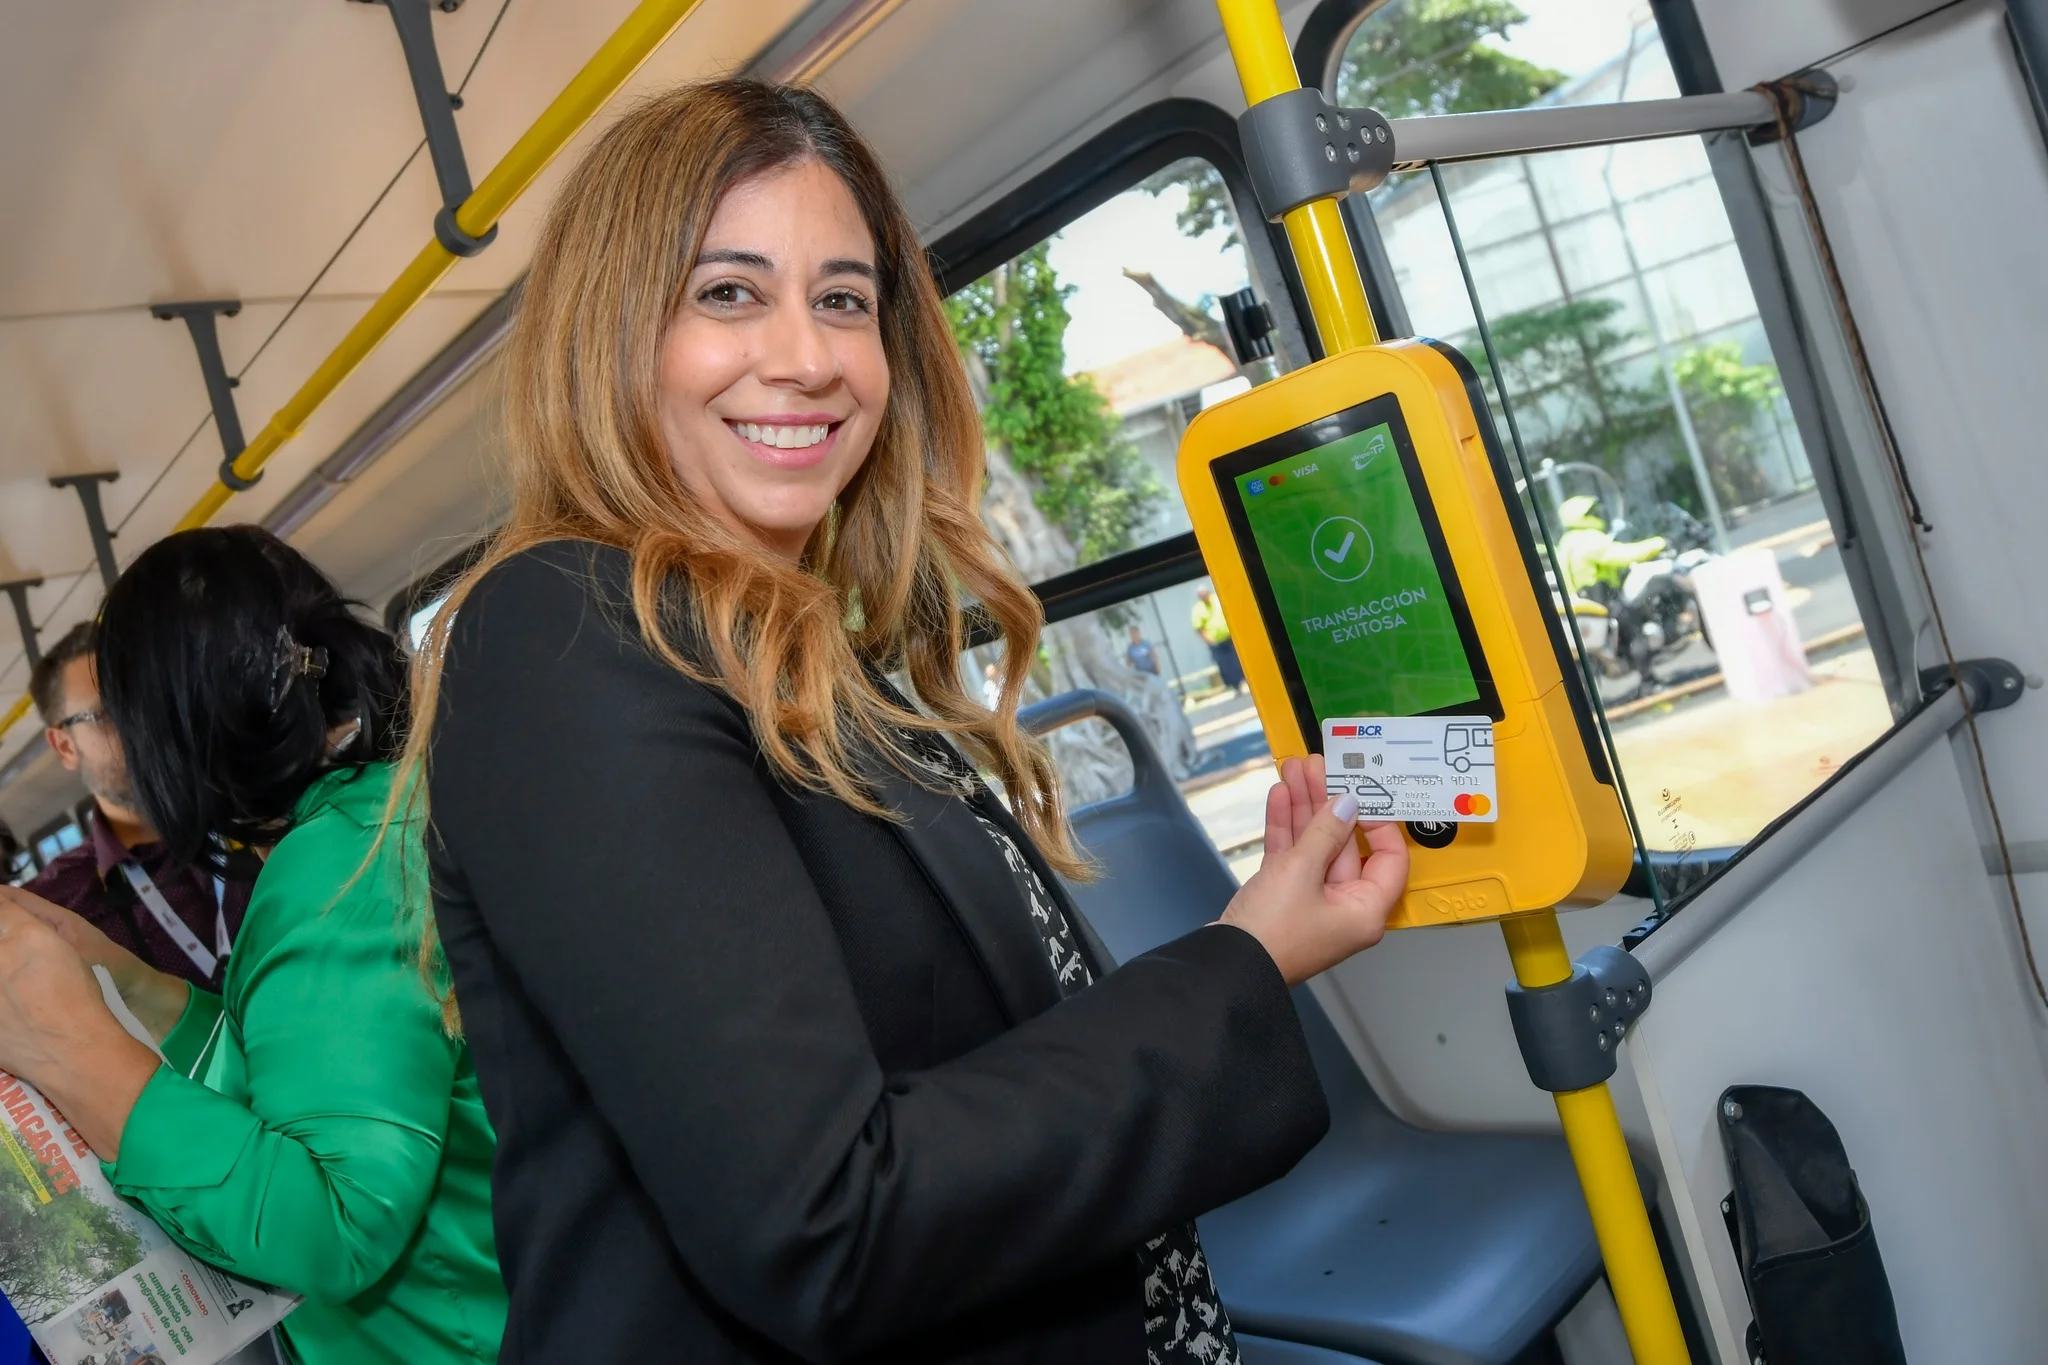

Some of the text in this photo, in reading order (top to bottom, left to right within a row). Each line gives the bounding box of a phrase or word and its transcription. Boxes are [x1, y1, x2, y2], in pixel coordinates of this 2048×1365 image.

[1292, 463, 1319, 478] VISA
[1301, 587, 1427, 633] TRANSACCIÓN
[1332, 613, 1407, 643] EXITOSA
[1357, 725, 1382, 736] BCR
[1380, 775, 1407, 785] 1802
[0, 1068, 81, 1195] ANACASTE
[148, 1271, 194, 1343] cumpliendo con
[170, 1283, 192, 1317] Vienen
[182, 1273, 209, 1316] CORONADO
[132, 1272, 187, 1356] programa de obras
